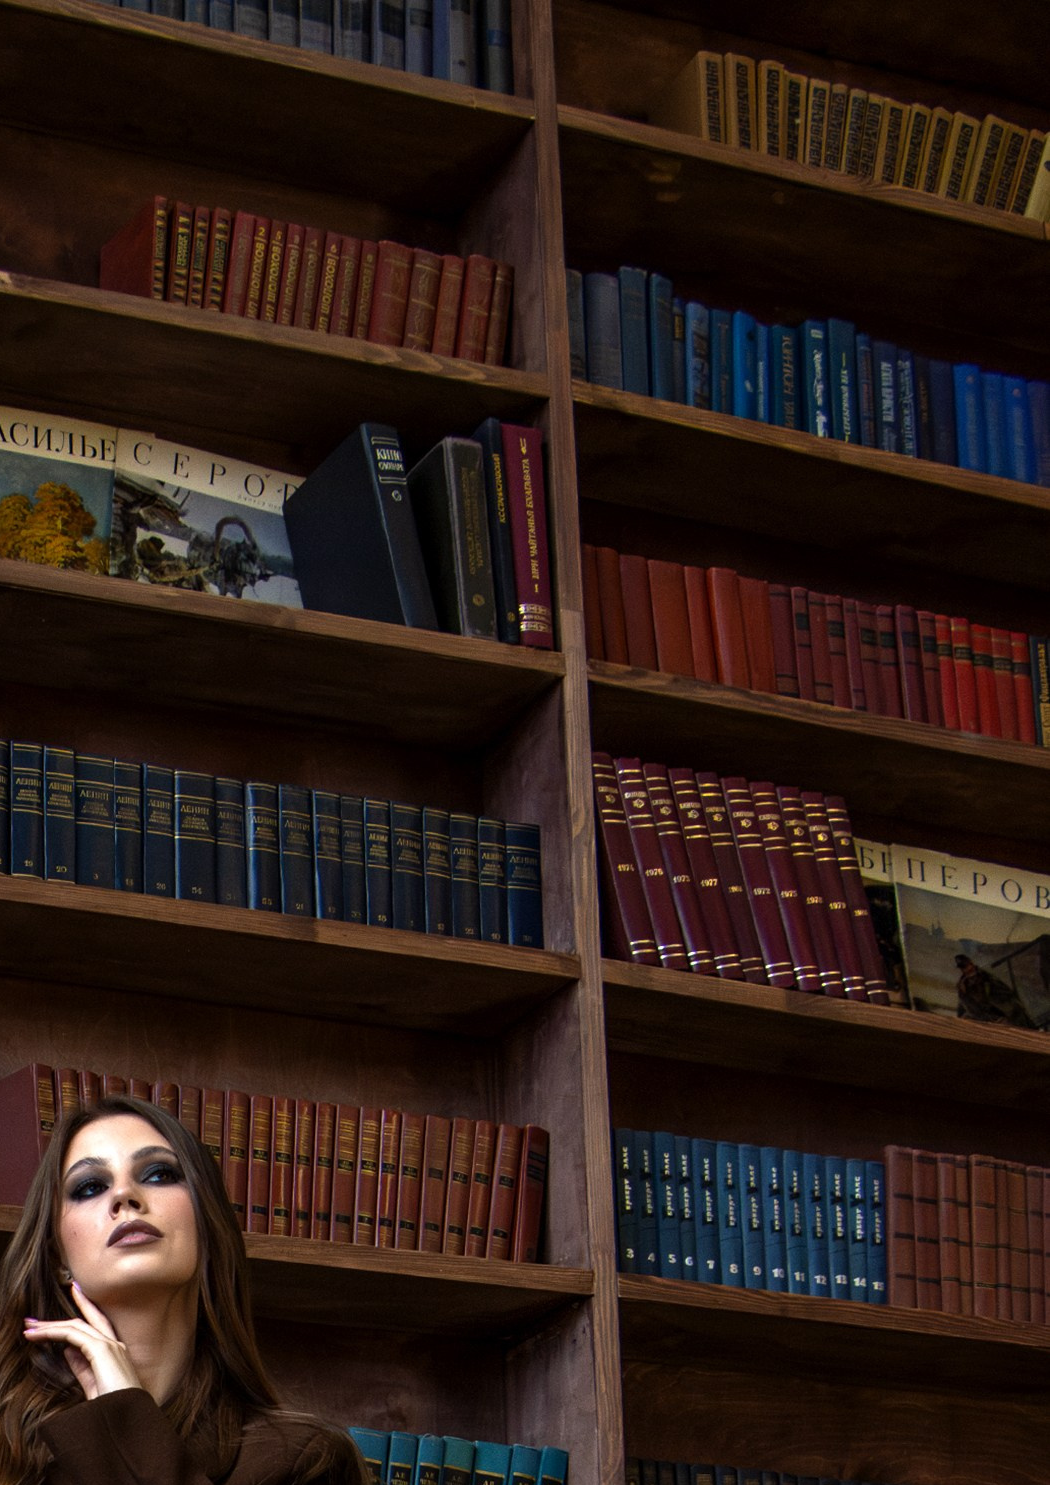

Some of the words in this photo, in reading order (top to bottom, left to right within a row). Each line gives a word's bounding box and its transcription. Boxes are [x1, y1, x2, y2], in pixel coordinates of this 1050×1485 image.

[907, 857, 1050, 910] ПЕРОВ
[626, 1248, 634, 1259] 3
[668, 1254, 676, 1263] 5
[685, 1257, 693, 1266] 6
[707, 1260, 715, 1269] 7
[730, 1264, 738, 1273] 8
[753, 1266, 761, 1275] 9
[773, 1268, 784, 1278] 10
[795, 1272, 805, 1281] 11
[814, 1275, 827, 1285] 12
[854, 1277, 866, 1287] 14
[873, 1281, 884, 1291] 15
